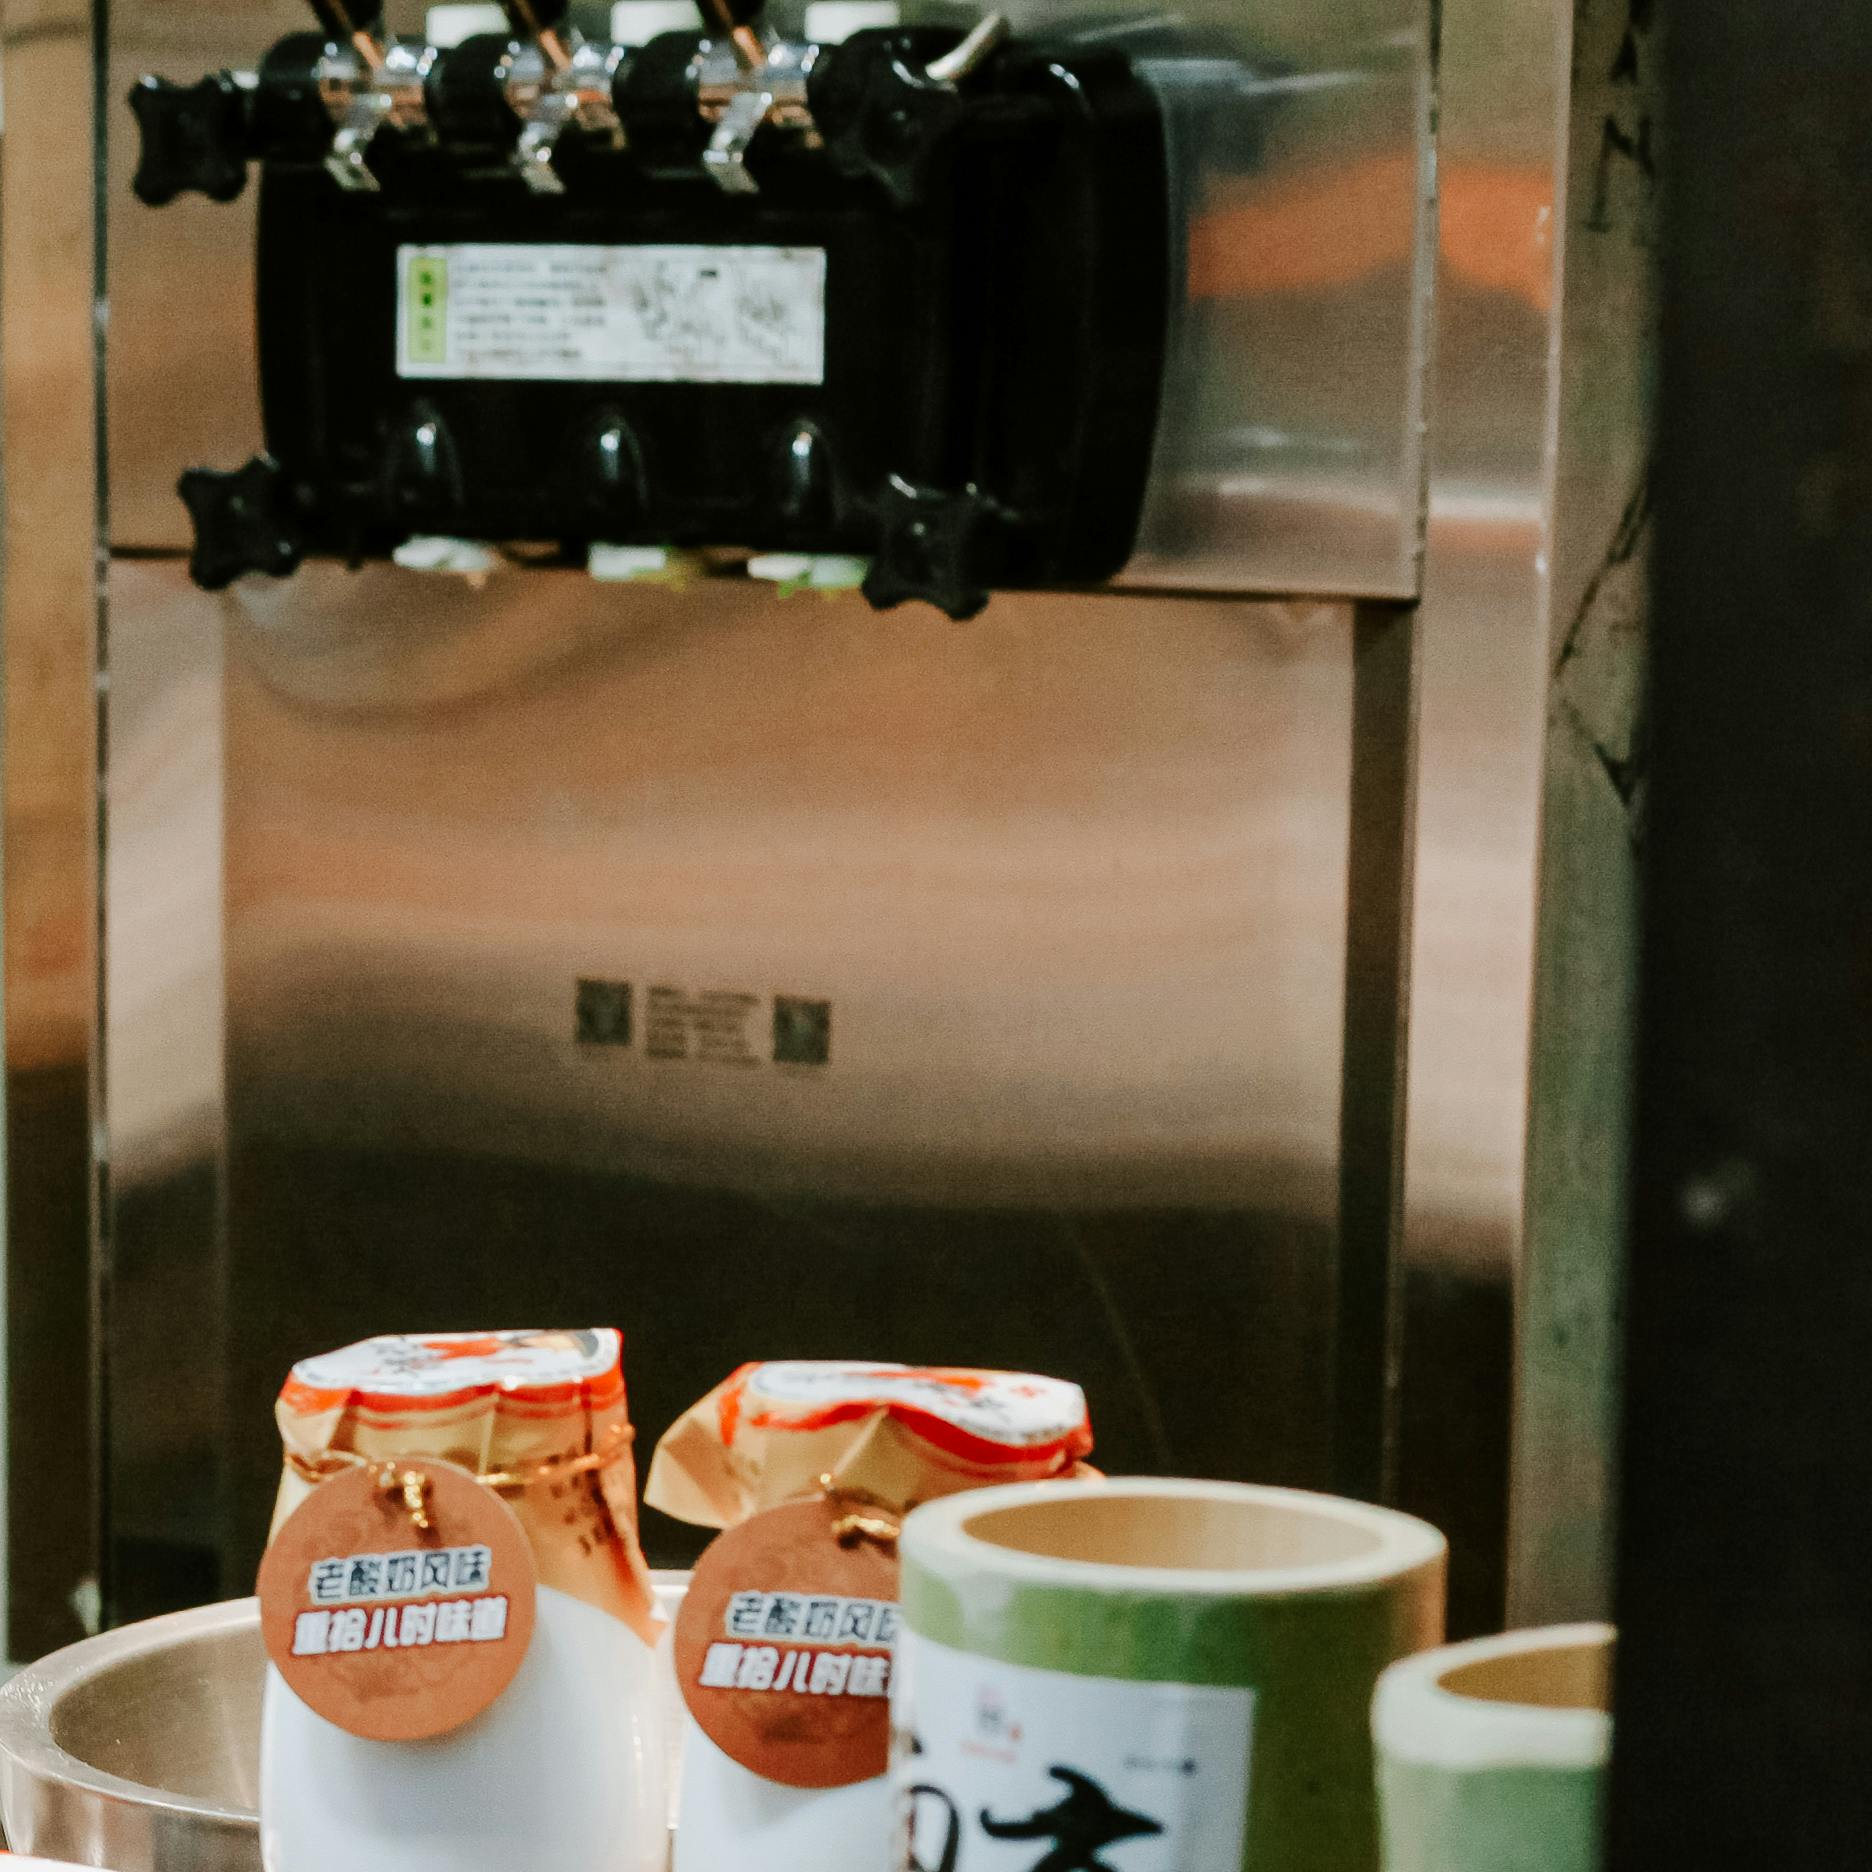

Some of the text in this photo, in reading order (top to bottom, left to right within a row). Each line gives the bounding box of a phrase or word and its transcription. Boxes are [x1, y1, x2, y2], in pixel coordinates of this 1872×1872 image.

[312, 1546, 490, 1603] 老酸奶风味
[292, 1595, 508, 1655] 重拾儿时味道
